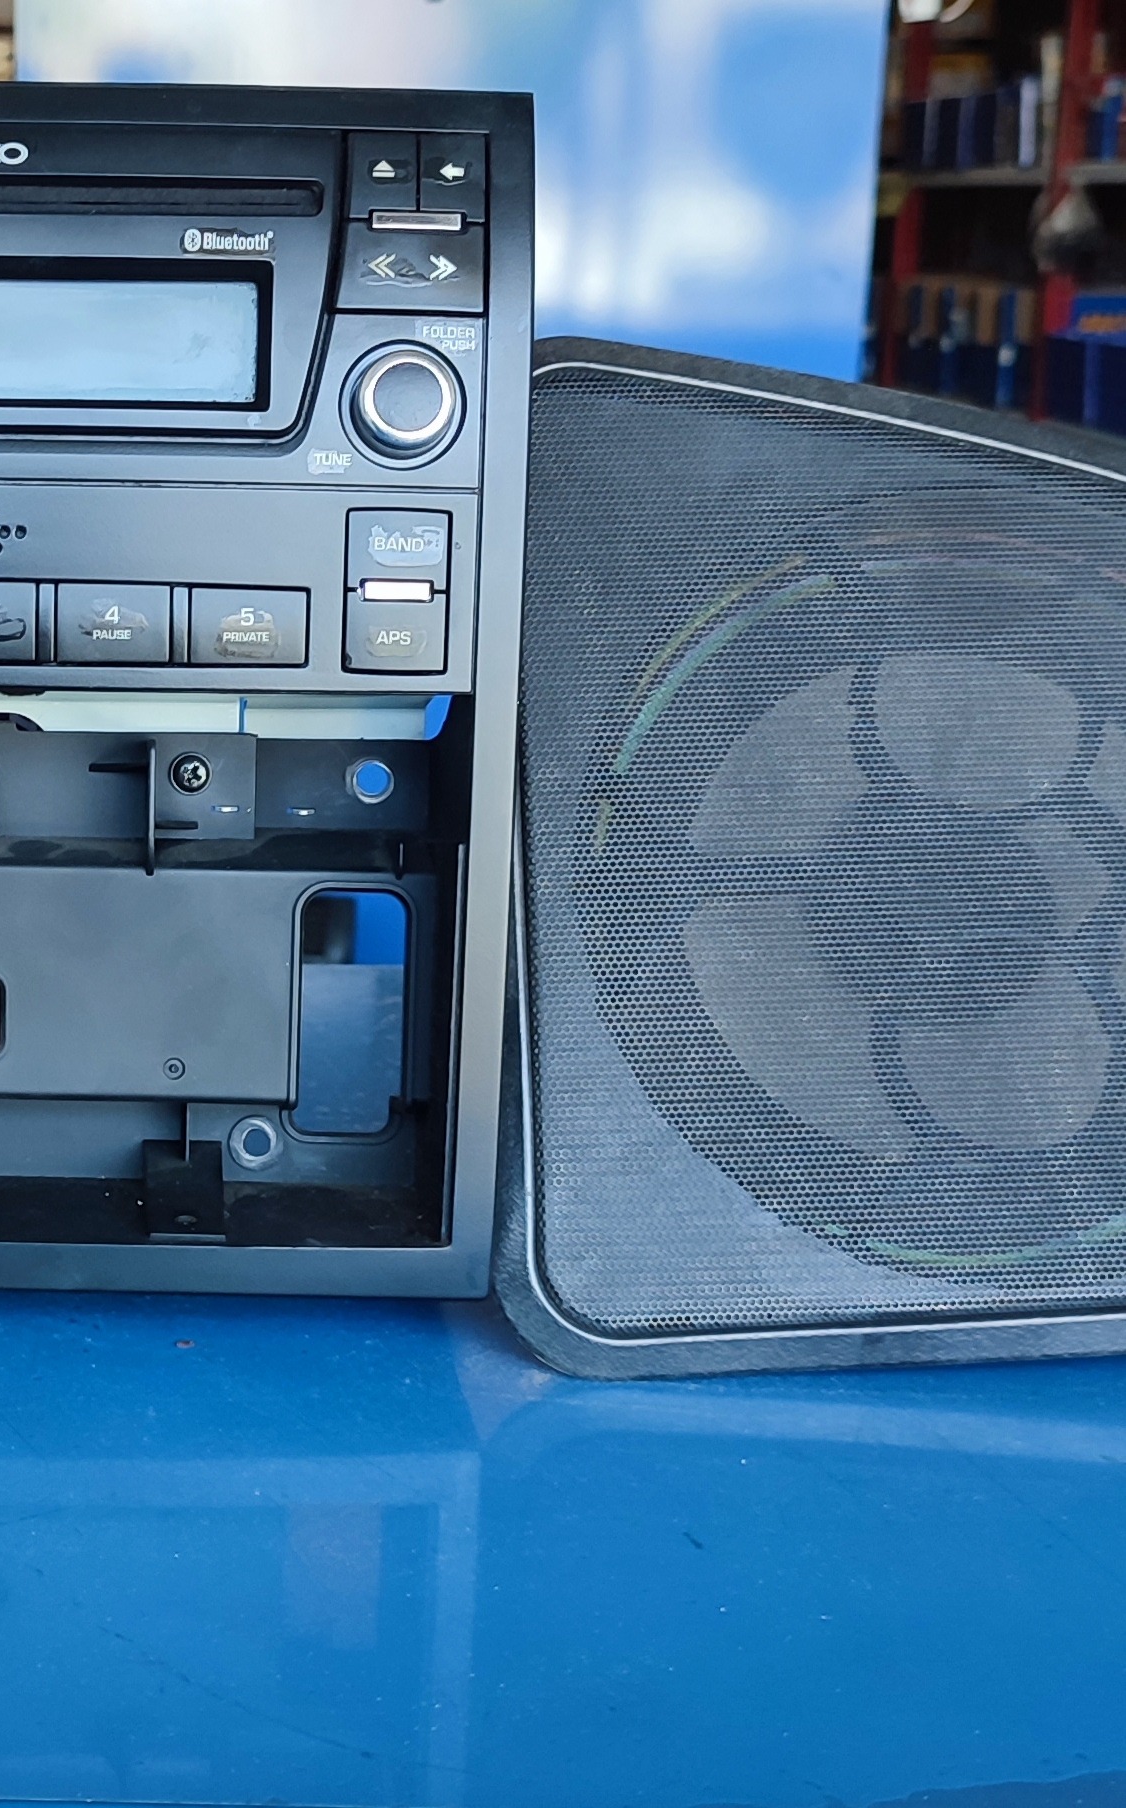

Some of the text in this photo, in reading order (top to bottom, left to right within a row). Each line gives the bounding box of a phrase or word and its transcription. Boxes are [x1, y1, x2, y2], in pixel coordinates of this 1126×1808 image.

[422, 326, 475, 339] FOLDER
[441, 339, 475, 350] PUSH
[313, 453, 352, 467] TUNE
[374, 537, 425, 553] BAND
[104, 605, 120, 624] 4
[240, 607, 255, 626] 5
[92, 629, 132, 641] PAUSE
[222, 632, 270, 643] PRIVATE
[376, 630, 412, 646] APS
